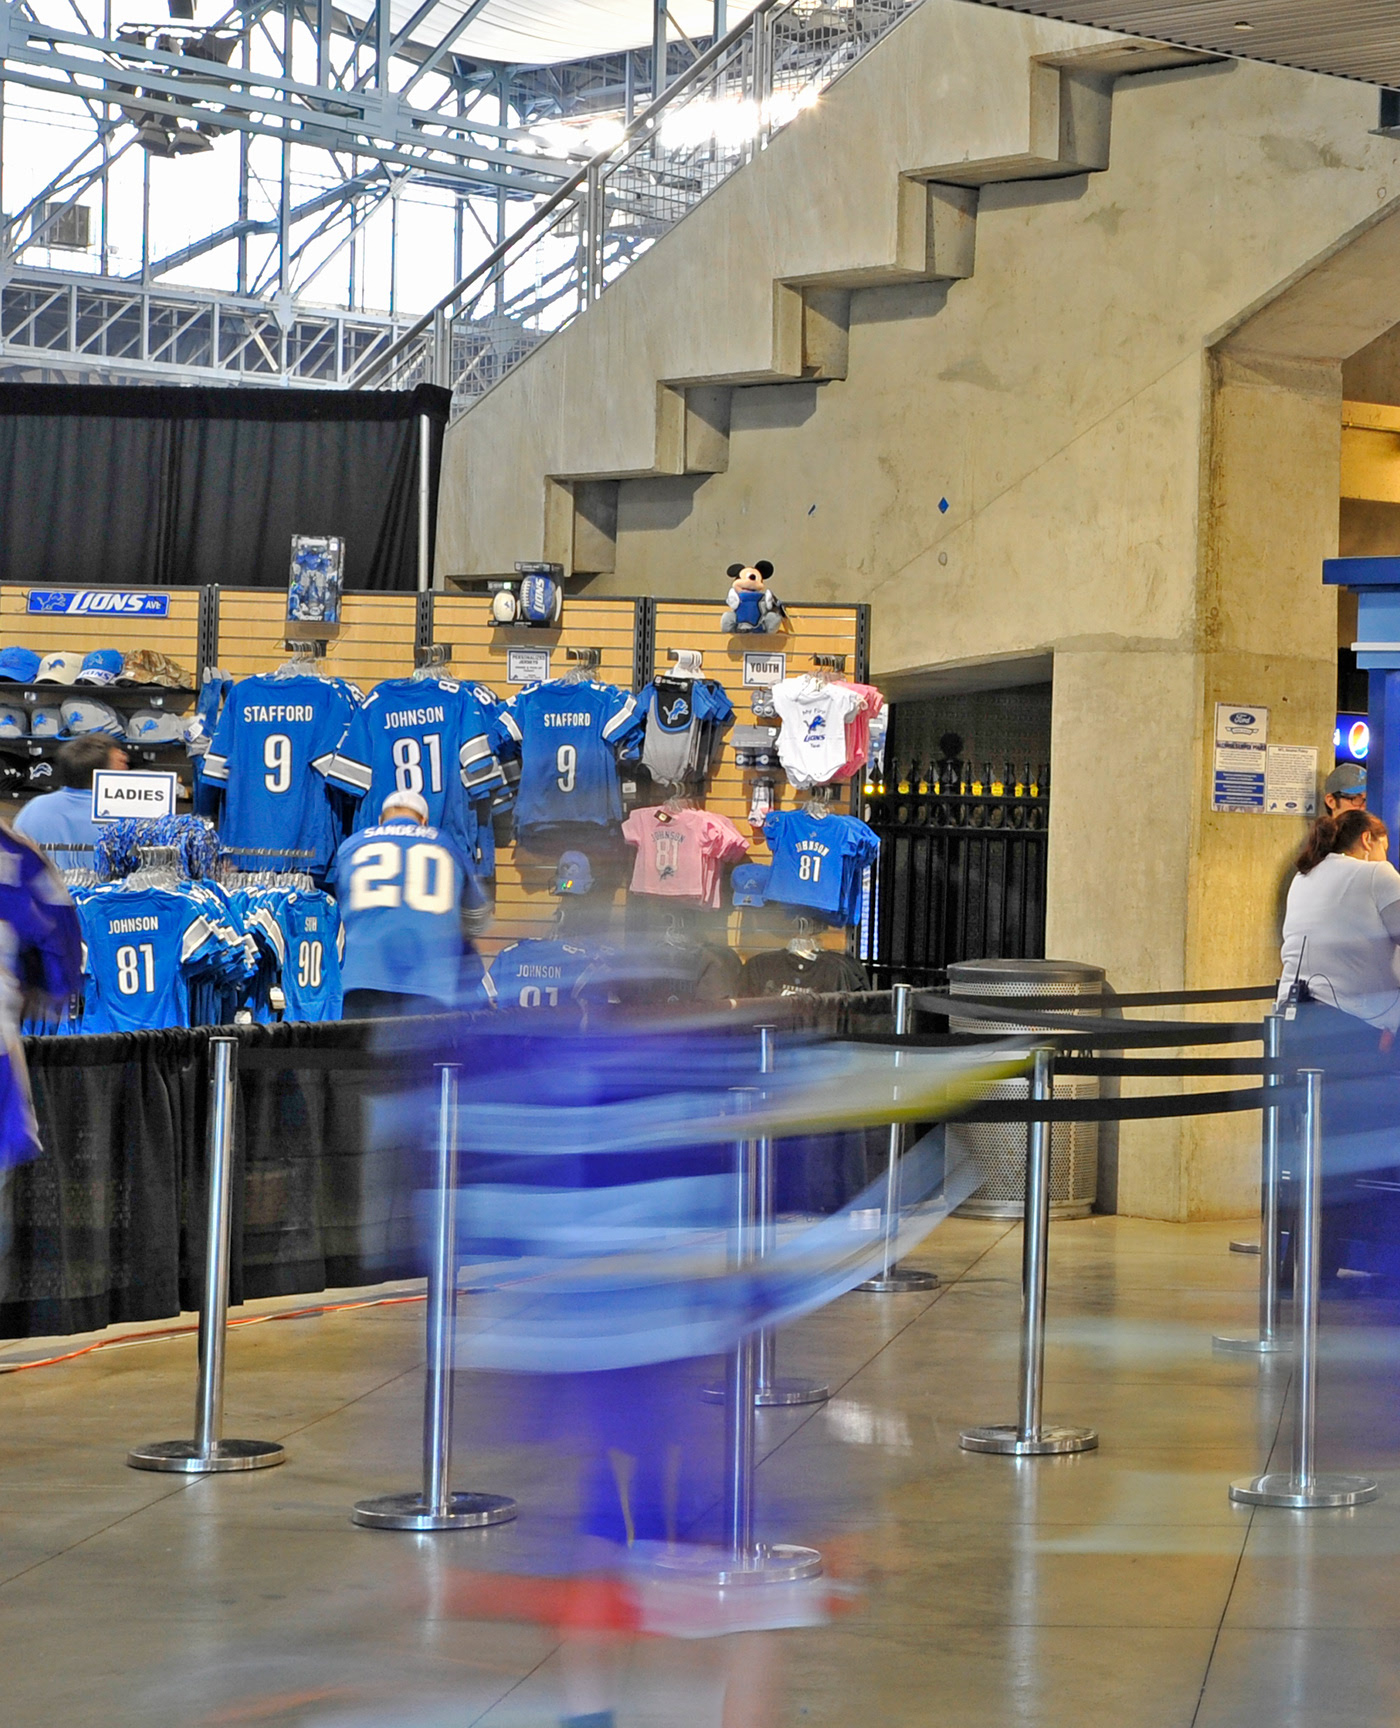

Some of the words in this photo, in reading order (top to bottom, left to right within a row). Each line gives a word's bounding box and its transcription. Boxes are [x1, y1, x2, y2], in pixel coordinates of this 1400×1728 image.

[65, 590, 148, 614] LIONS
[533, 577, 546, 614] LIONS
[750, 662, 780, 673] YOUTH
[243, 705, 314, 723] STAFFORD
[384, 706, 445, 730] JOHNSON
[543, 712, 591, 728] STAFFORD
[264, 732, 292, 795] 9
[392, 732, 443, 794] 81
[556, 743, 578, 793] 9
[104, 787, 165, 802] LADIES
[651, 830, 686, 844] JOHNSON
[795, 840, 830, 857] JOHNSON
[655, 839, 679, 872] 81
[350, 841, 455, 915] 20
[798, 854, 822, 883] 81
[108, 916, 159, 935] JOHNSON
[304, 916, 318, 933] SUH
[115, 943, 156, 995] 81
[297, 940, 323, 988] 90
[516, 964, 562, 979] JOHNSON
